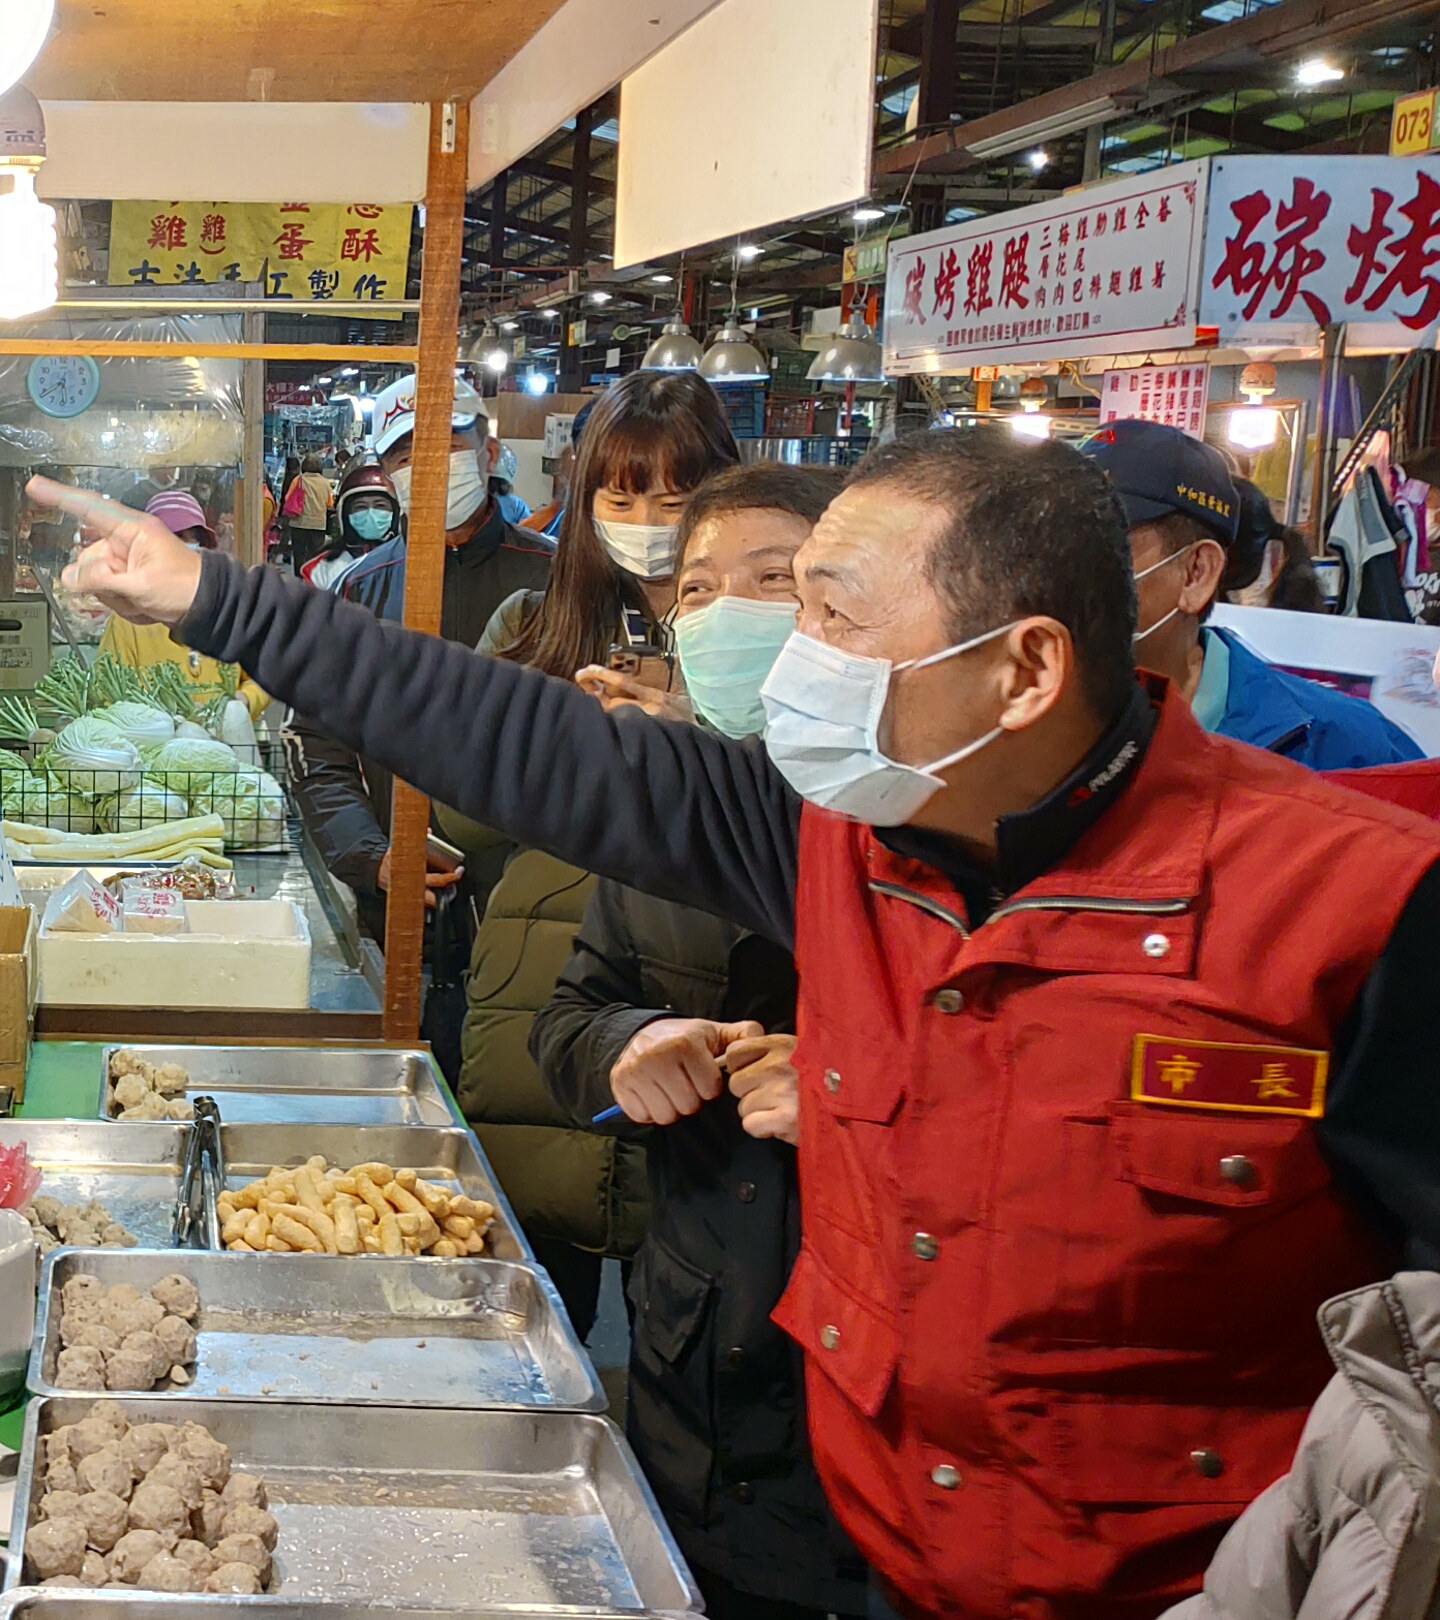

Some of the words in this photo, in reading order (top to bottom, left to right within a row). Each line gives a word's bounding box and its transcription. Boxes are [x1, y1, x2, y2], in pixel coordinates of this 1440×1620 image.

[1396, 107, 1430, 144] 073
[902, 231, 1030, 326] 碳烤雞腿
[1212, 170, 1440, 330] 碳烤
[1156, 1054, 1300, 1099] 市長
